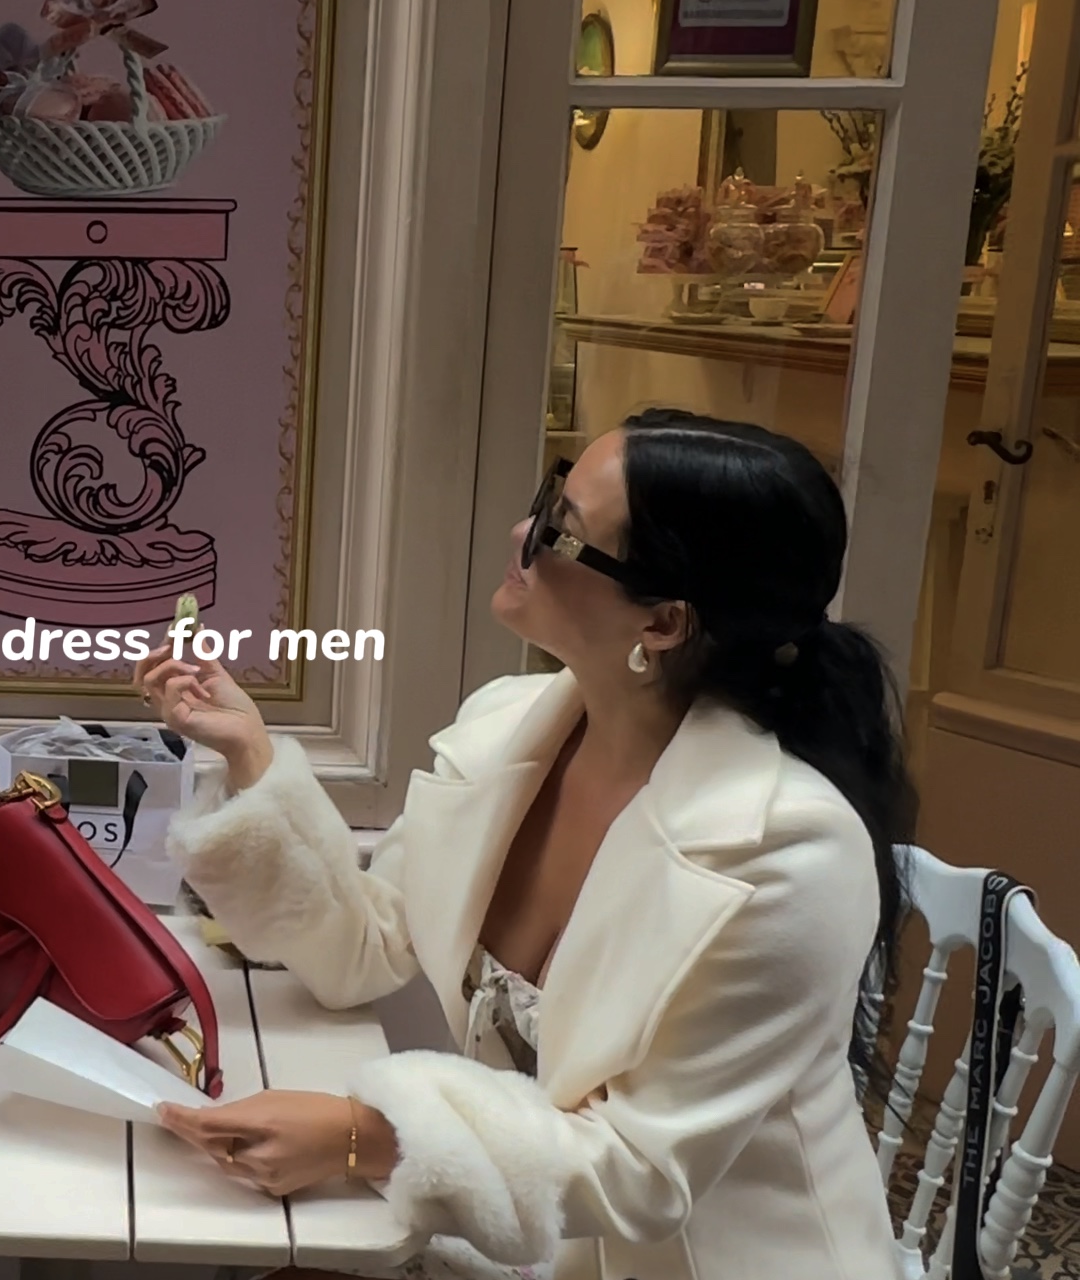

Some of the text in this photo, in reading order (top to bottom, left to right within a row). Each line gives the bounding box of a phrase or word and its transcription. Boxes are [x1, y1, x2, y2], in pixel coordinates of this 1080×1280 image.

[962, 874, 1009, 1188] THE MARC JACOBS
